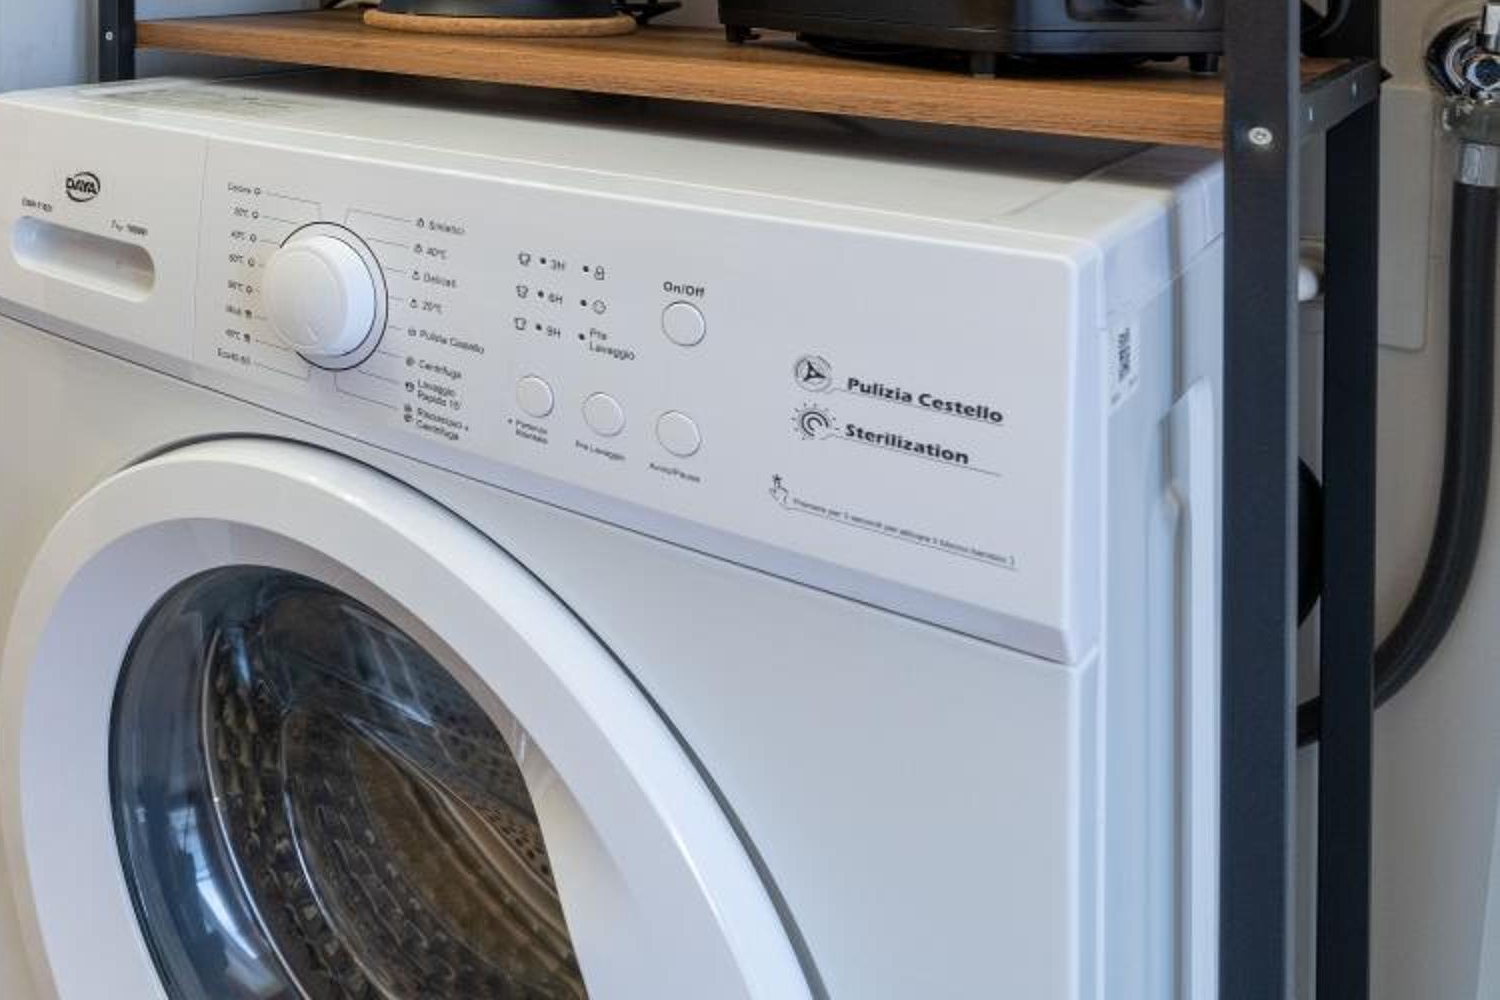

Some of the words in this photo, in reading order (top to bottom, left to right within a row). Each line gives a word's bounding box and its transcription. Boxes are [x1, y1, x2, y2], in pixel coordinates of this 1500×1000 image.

[662, 280, 706, 299] On/Off
[589, 340, 636, 361] Lavaggio
[847, 376, 913, 406] Pulizia
[918, 392, 1004, 425] Cestello
[844, 422, 970, 467] Sterilization
